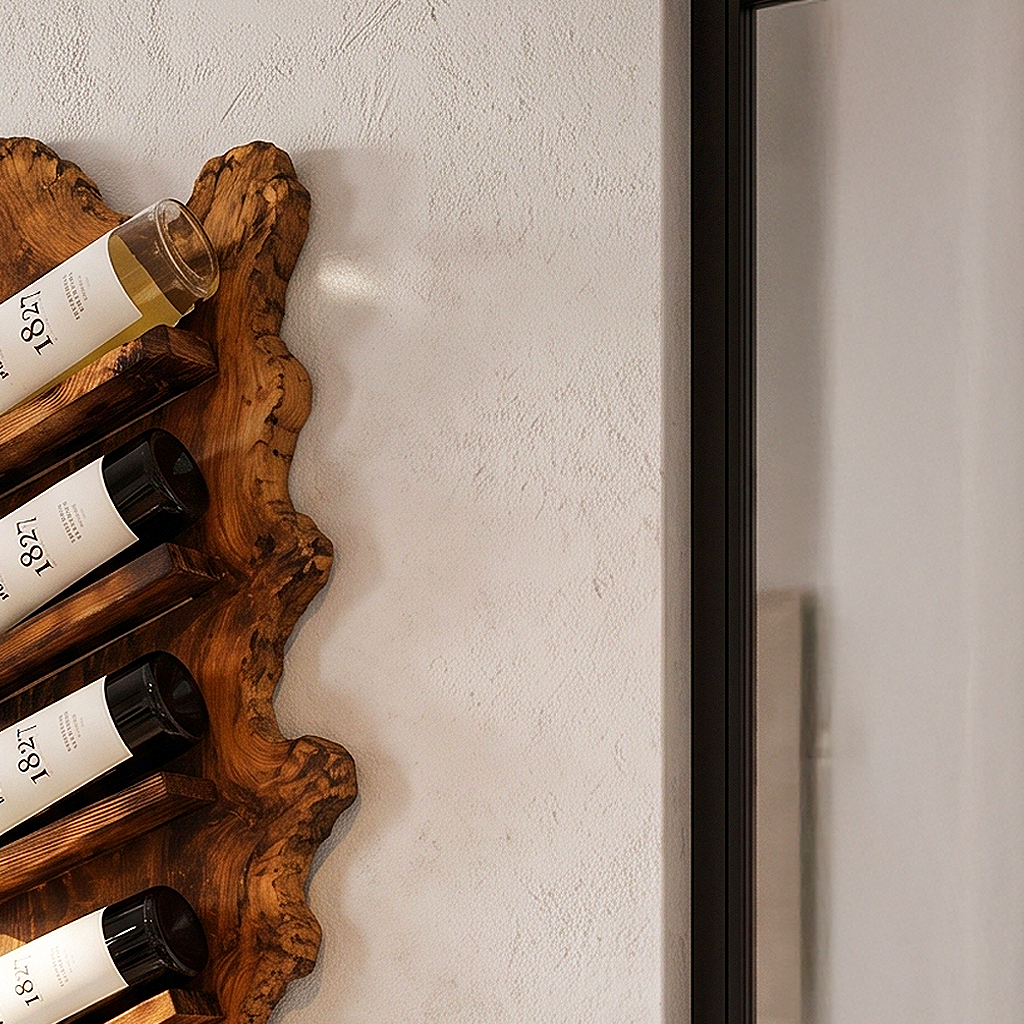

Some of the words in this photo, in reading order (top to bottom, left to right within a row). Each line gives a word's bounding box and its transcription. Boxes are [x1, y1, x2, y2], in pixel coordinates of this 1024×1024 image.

[20, 291, 54, 355] 1827
[16, 516, 54, 577] 1827
[17, 724, 50, 785] 1827
[14, 955, 41, 1007] 1827
